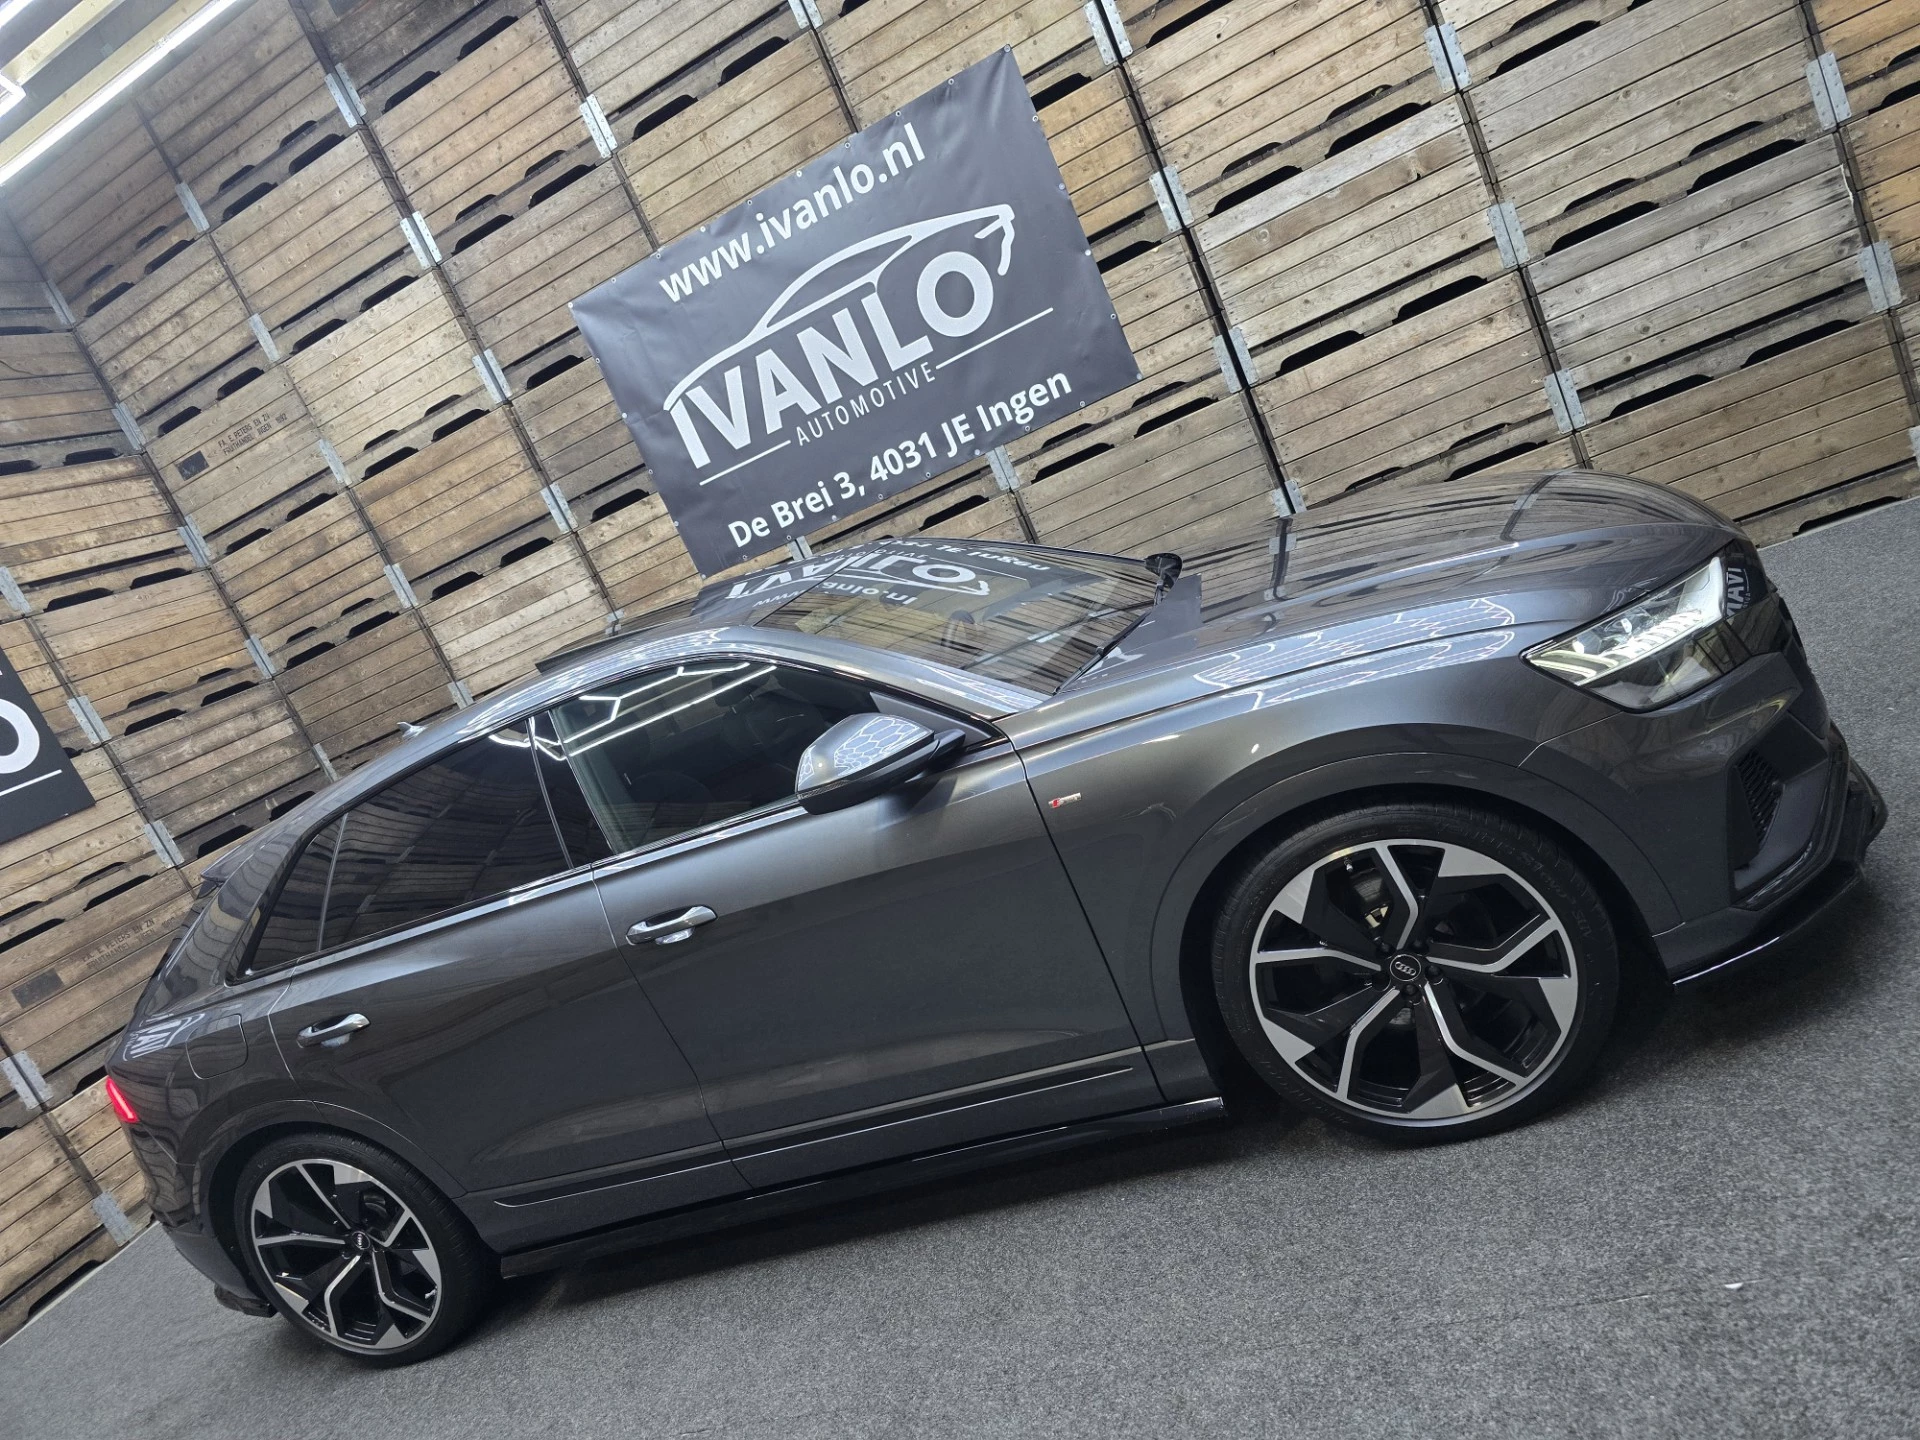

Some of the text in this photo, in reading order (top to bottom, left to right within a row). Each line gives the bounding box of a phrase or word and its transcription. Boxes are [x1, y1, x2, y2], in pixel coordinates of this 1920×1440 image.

[658, 122, 926, 302] www.ivanlo.nl
[669, 251, 994, 469] IVANLO
[796, 361, 936, 446] AUTOMOTIVE
[728, 371, 1073, 547] De Brei 3, 4031 JE Ingen
